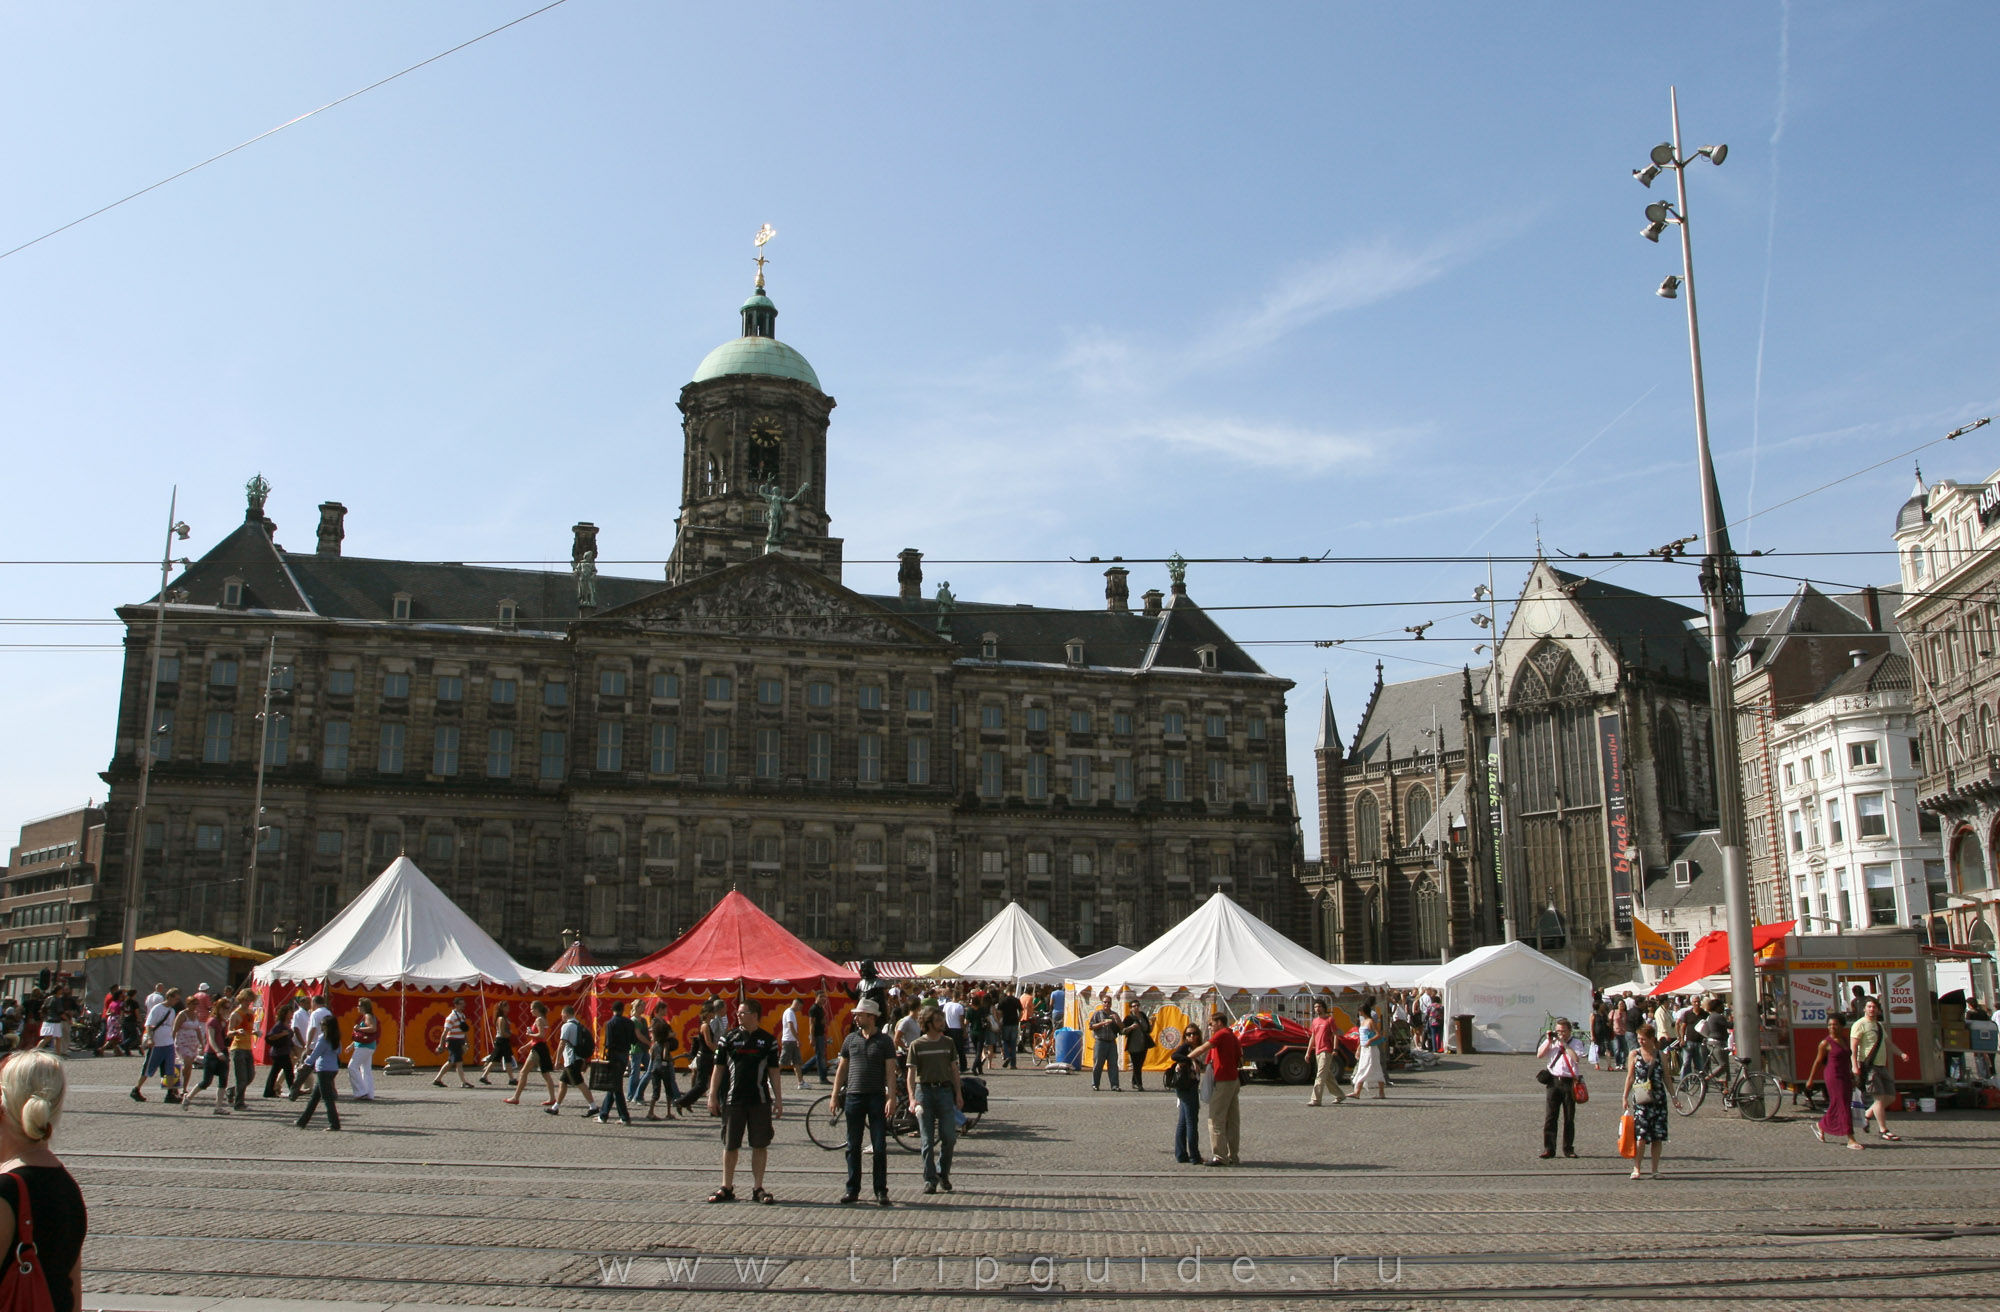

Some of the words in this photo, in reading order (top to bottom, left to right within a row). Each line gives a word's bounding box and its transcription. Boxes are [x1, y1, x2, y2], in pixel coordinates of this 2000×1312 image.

[1980, 481, 2000, 514] ABN
[1607, 733, 1620, 780] beautiful
[1612, 783, 1620, 792] is
[1488, 753, 1498, 807] black
[1494, 840, 1503, 884] beautiful
[1611, 814, 1630, 873] black
[1642, 948, 1672, 960] IJS
[1890, 996, 1914, 1004] DOGS
[1801, 1009, 1826, 1020] IJS
